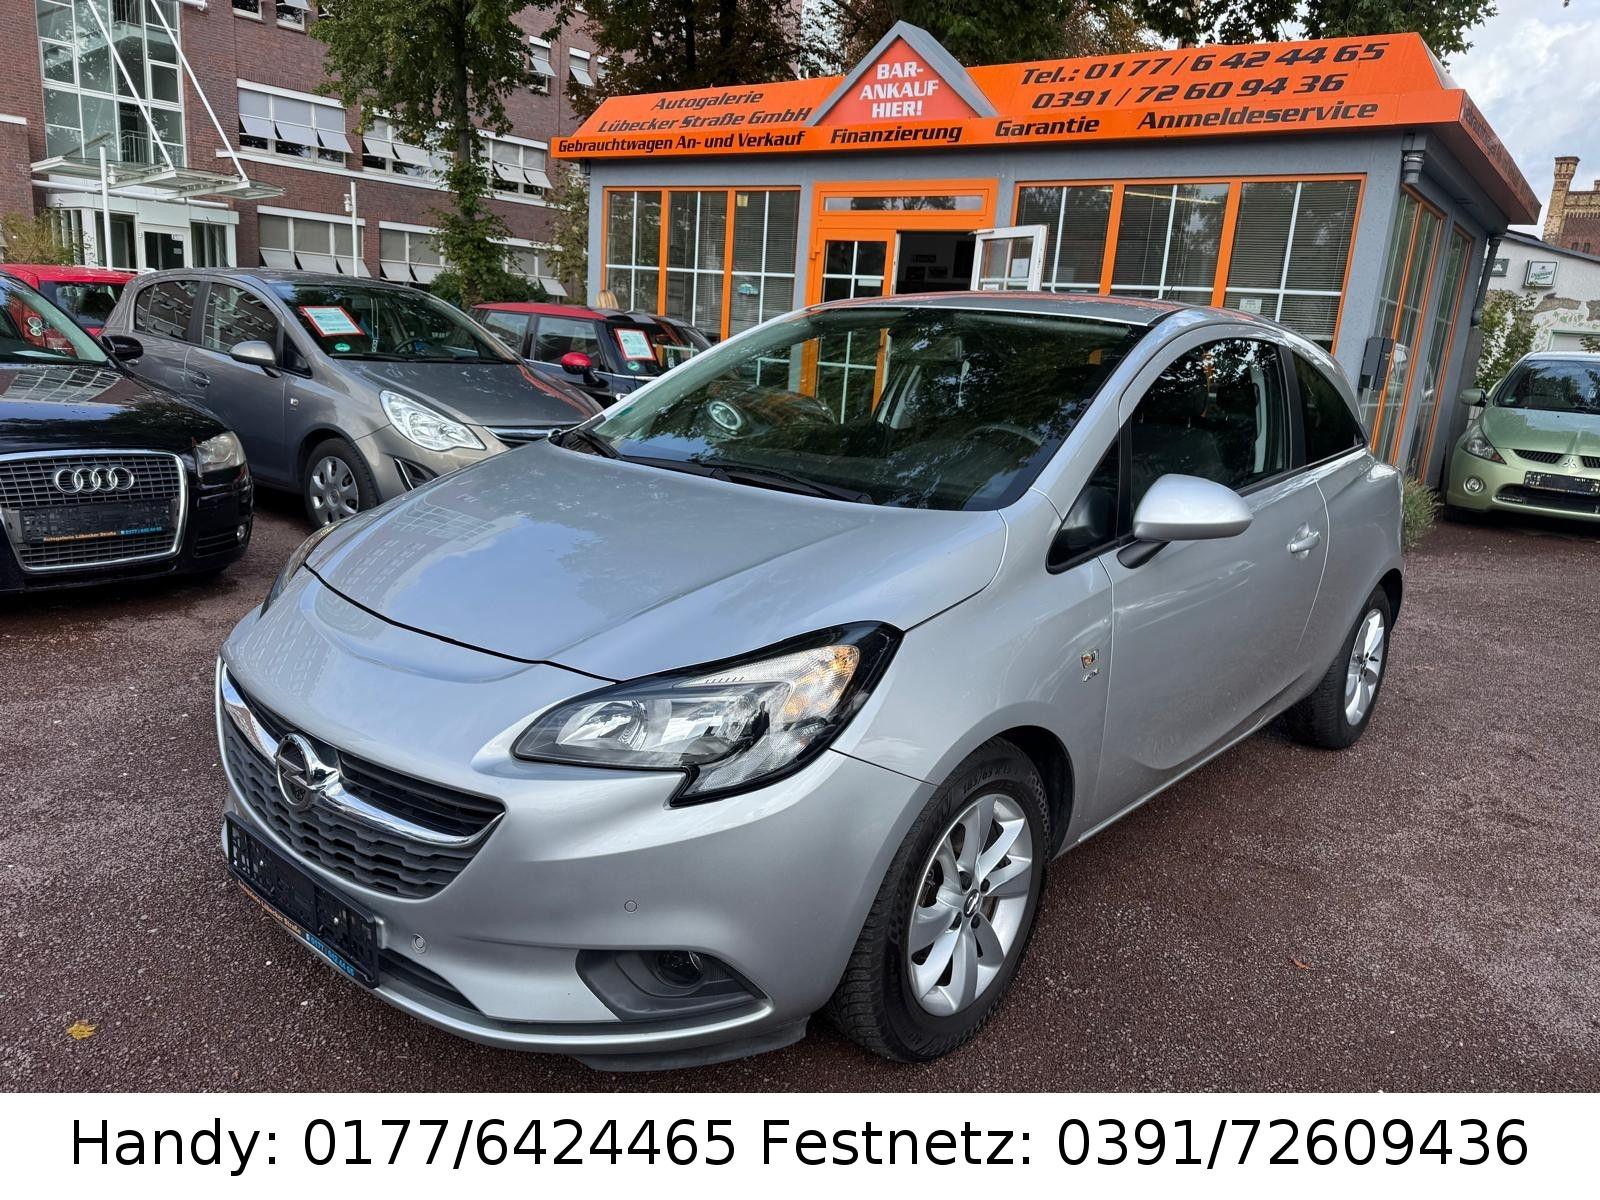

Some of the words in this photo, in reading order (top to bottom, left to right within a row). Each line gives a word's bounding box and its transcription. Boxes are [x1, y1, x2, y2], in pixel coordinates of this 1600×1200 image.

[876, 61, 924, 80] BAR-
[1021, 66, 1079, 86] Tel.:
[1219, 50, 1272, 70] 42
[1274, 46, 1327, 67] 44
[1332, 41, 1390, 63] 65
[859, 80, 939, 100] ANKAUF
[1135, 83, 1181, 103] 72
[1183, 80, 1234, 101] 60
[1235, 76, 1289, 98] 94
[1292, 72, 1349, 95] 36
[651, 90, 764, 112] Autogalerie
[871, 100, 923, 119] HIER!
[597, 117, 681, 134] Lübecker
[678, 112, 748, 130] Straße
[747, 107, 813, 125] GmbH
[994, 115, 1100, 138] Garantie
[1136, 100, 1380, 131] Anmeldeservice
[558, 137, 674, 154] Gebrauchtwagen
[675, 135, 702, 150] An-
[704, 132, 734, 148] und
[738, 131, 806, 148] Verkauf
[830, 125, 963, 145] Finanzierung
